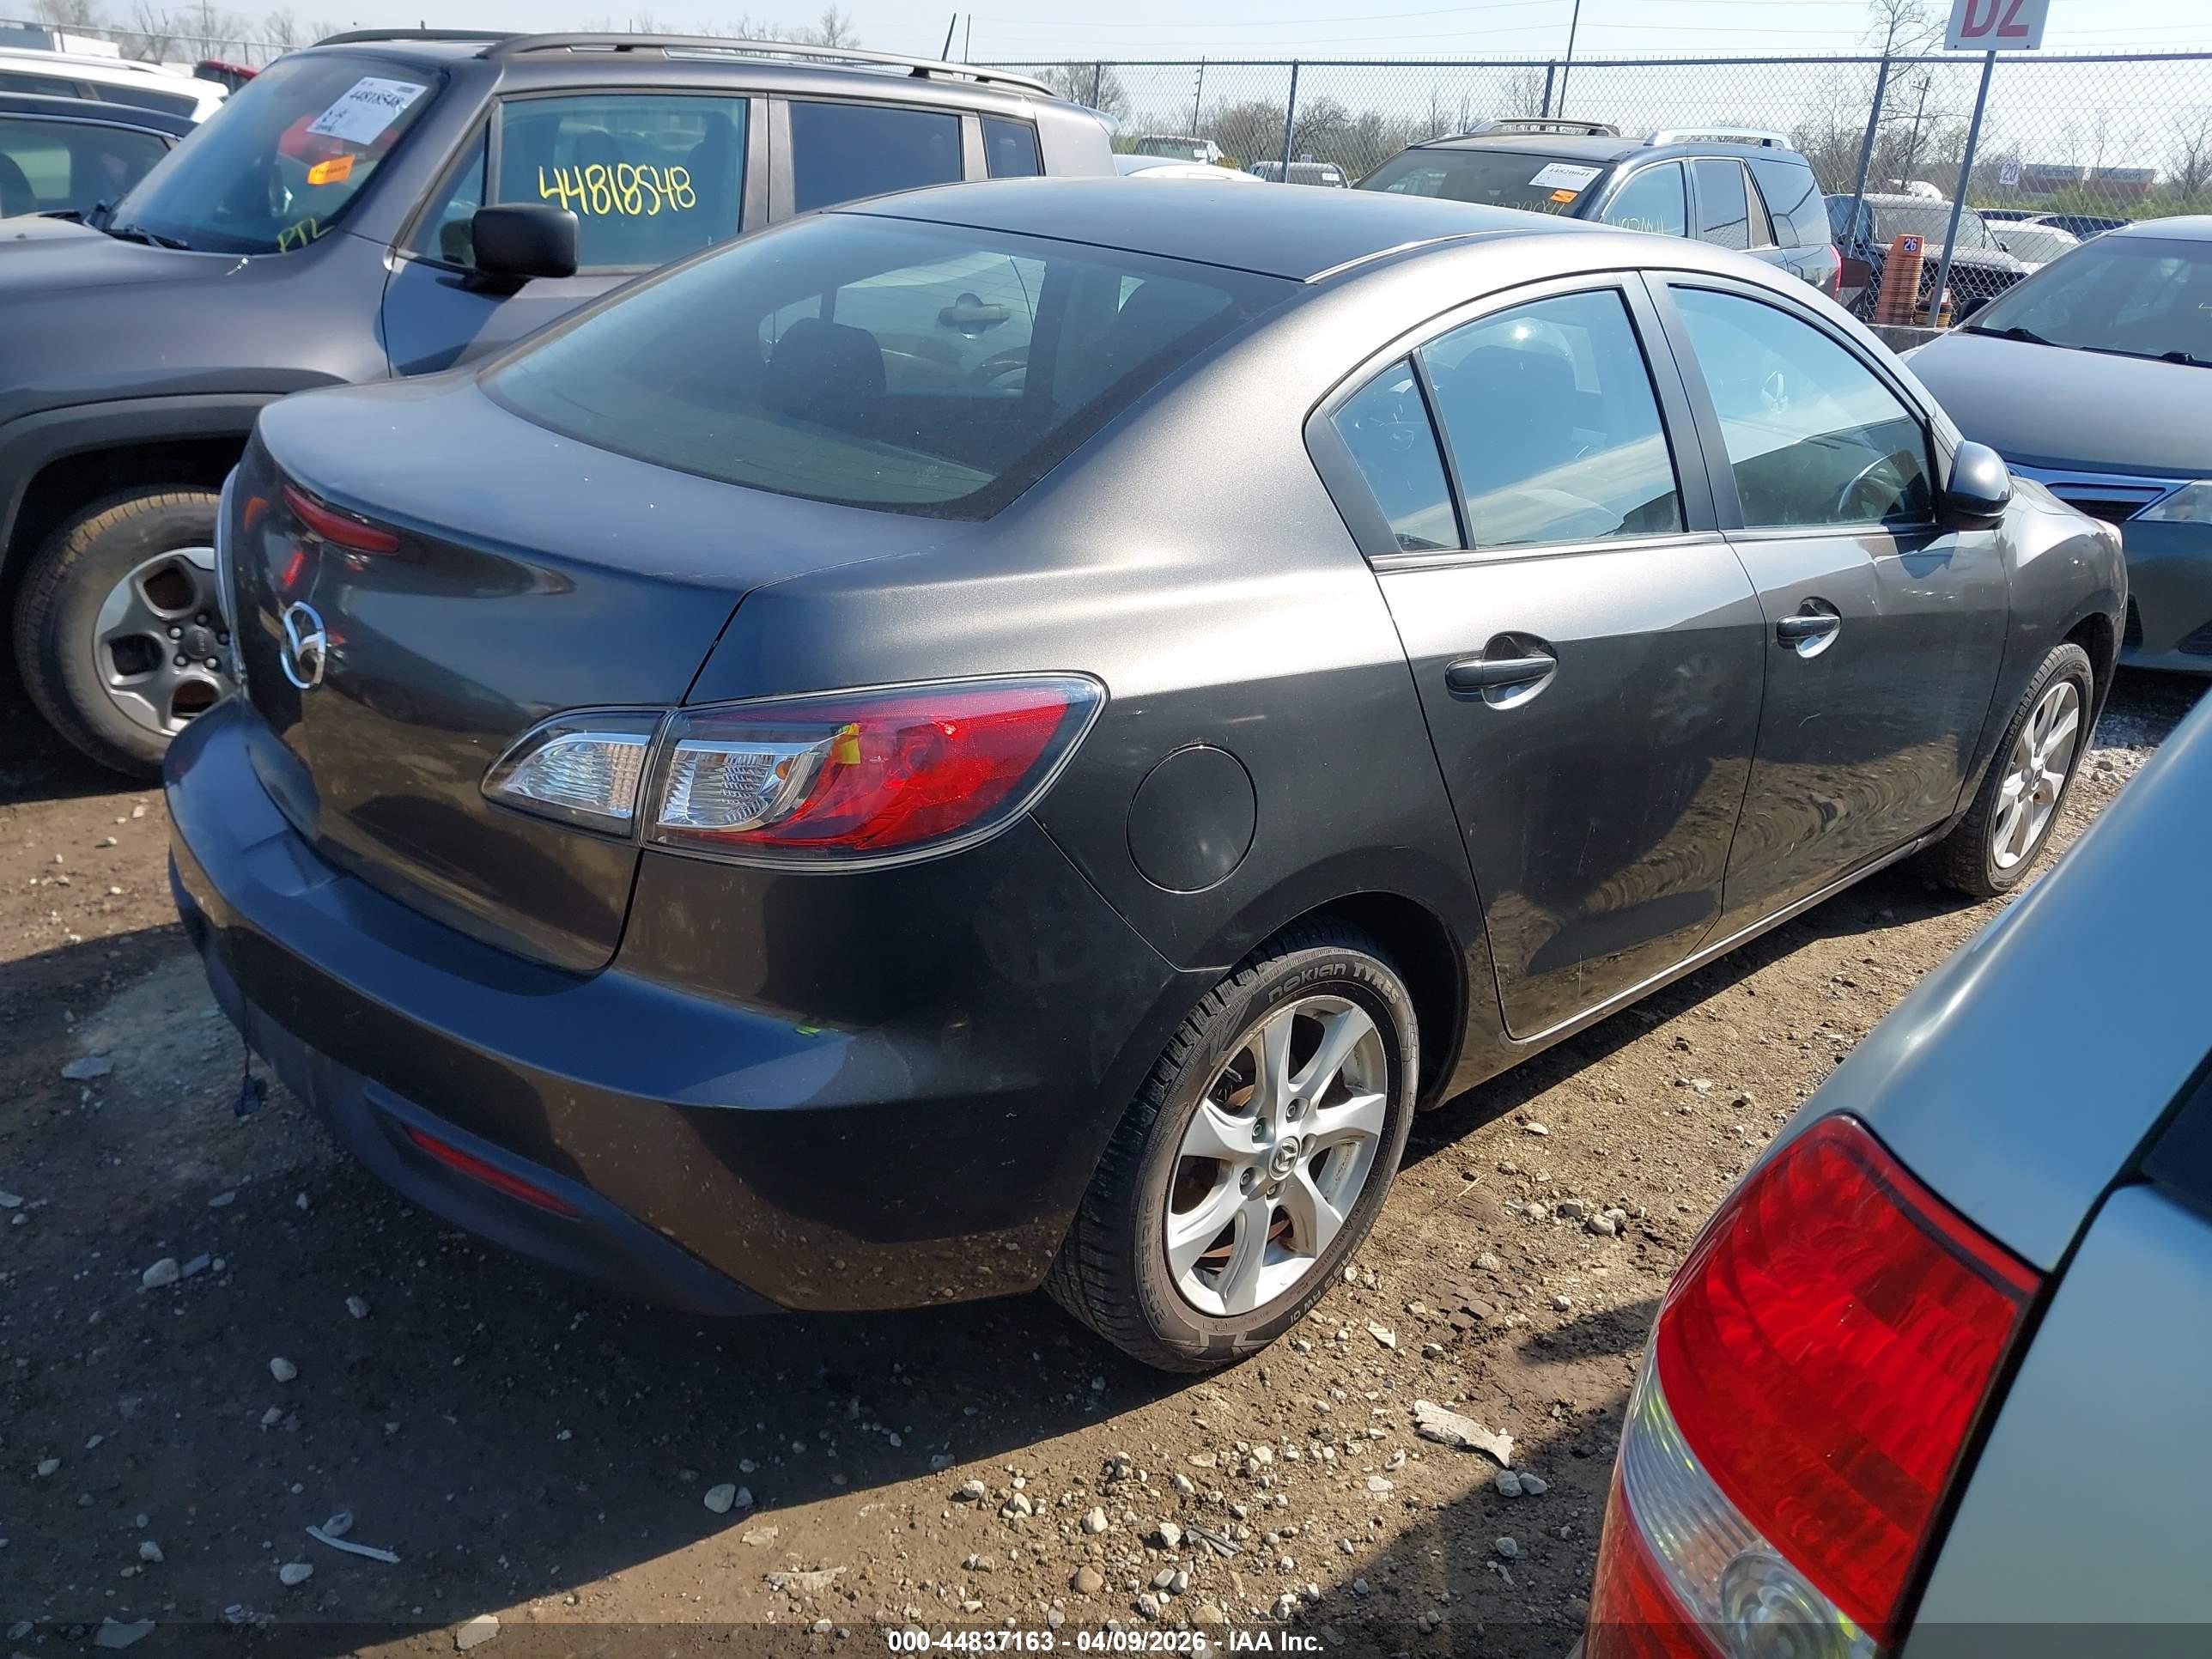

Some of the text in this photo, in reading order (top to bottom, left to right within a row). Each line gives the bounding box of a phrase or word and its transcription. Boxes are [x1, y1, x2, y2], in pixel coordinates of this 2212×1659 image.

[538, 162, 696, 216] 44818548
[1903, 238, 1917, 251] 26
[1352, 962, 1401, 1005] TYRES
